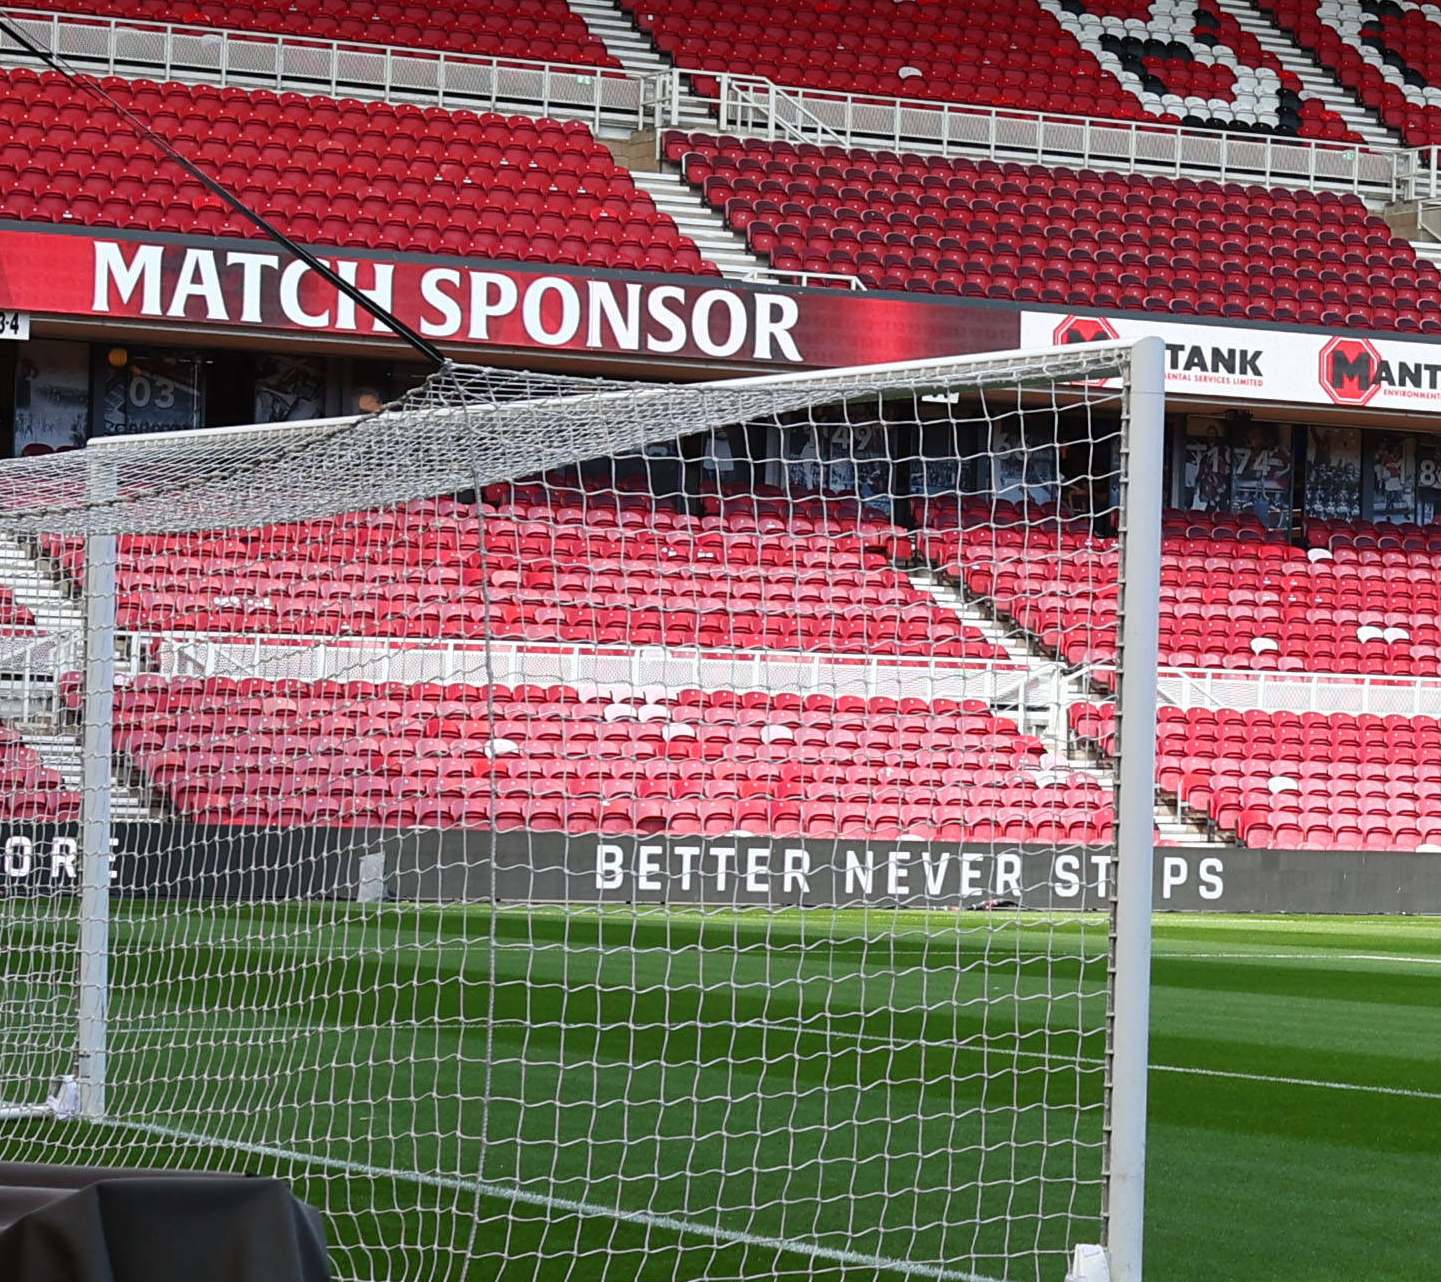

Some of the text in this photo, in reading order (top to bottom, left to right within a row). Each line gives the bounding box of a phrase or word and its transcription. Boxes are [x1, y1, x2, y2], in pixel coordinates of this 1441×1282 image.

[92, 240, 804, 363] MATCH SPONSOR
[596, 844, 1225, 901] BETTER NEVER STPS
